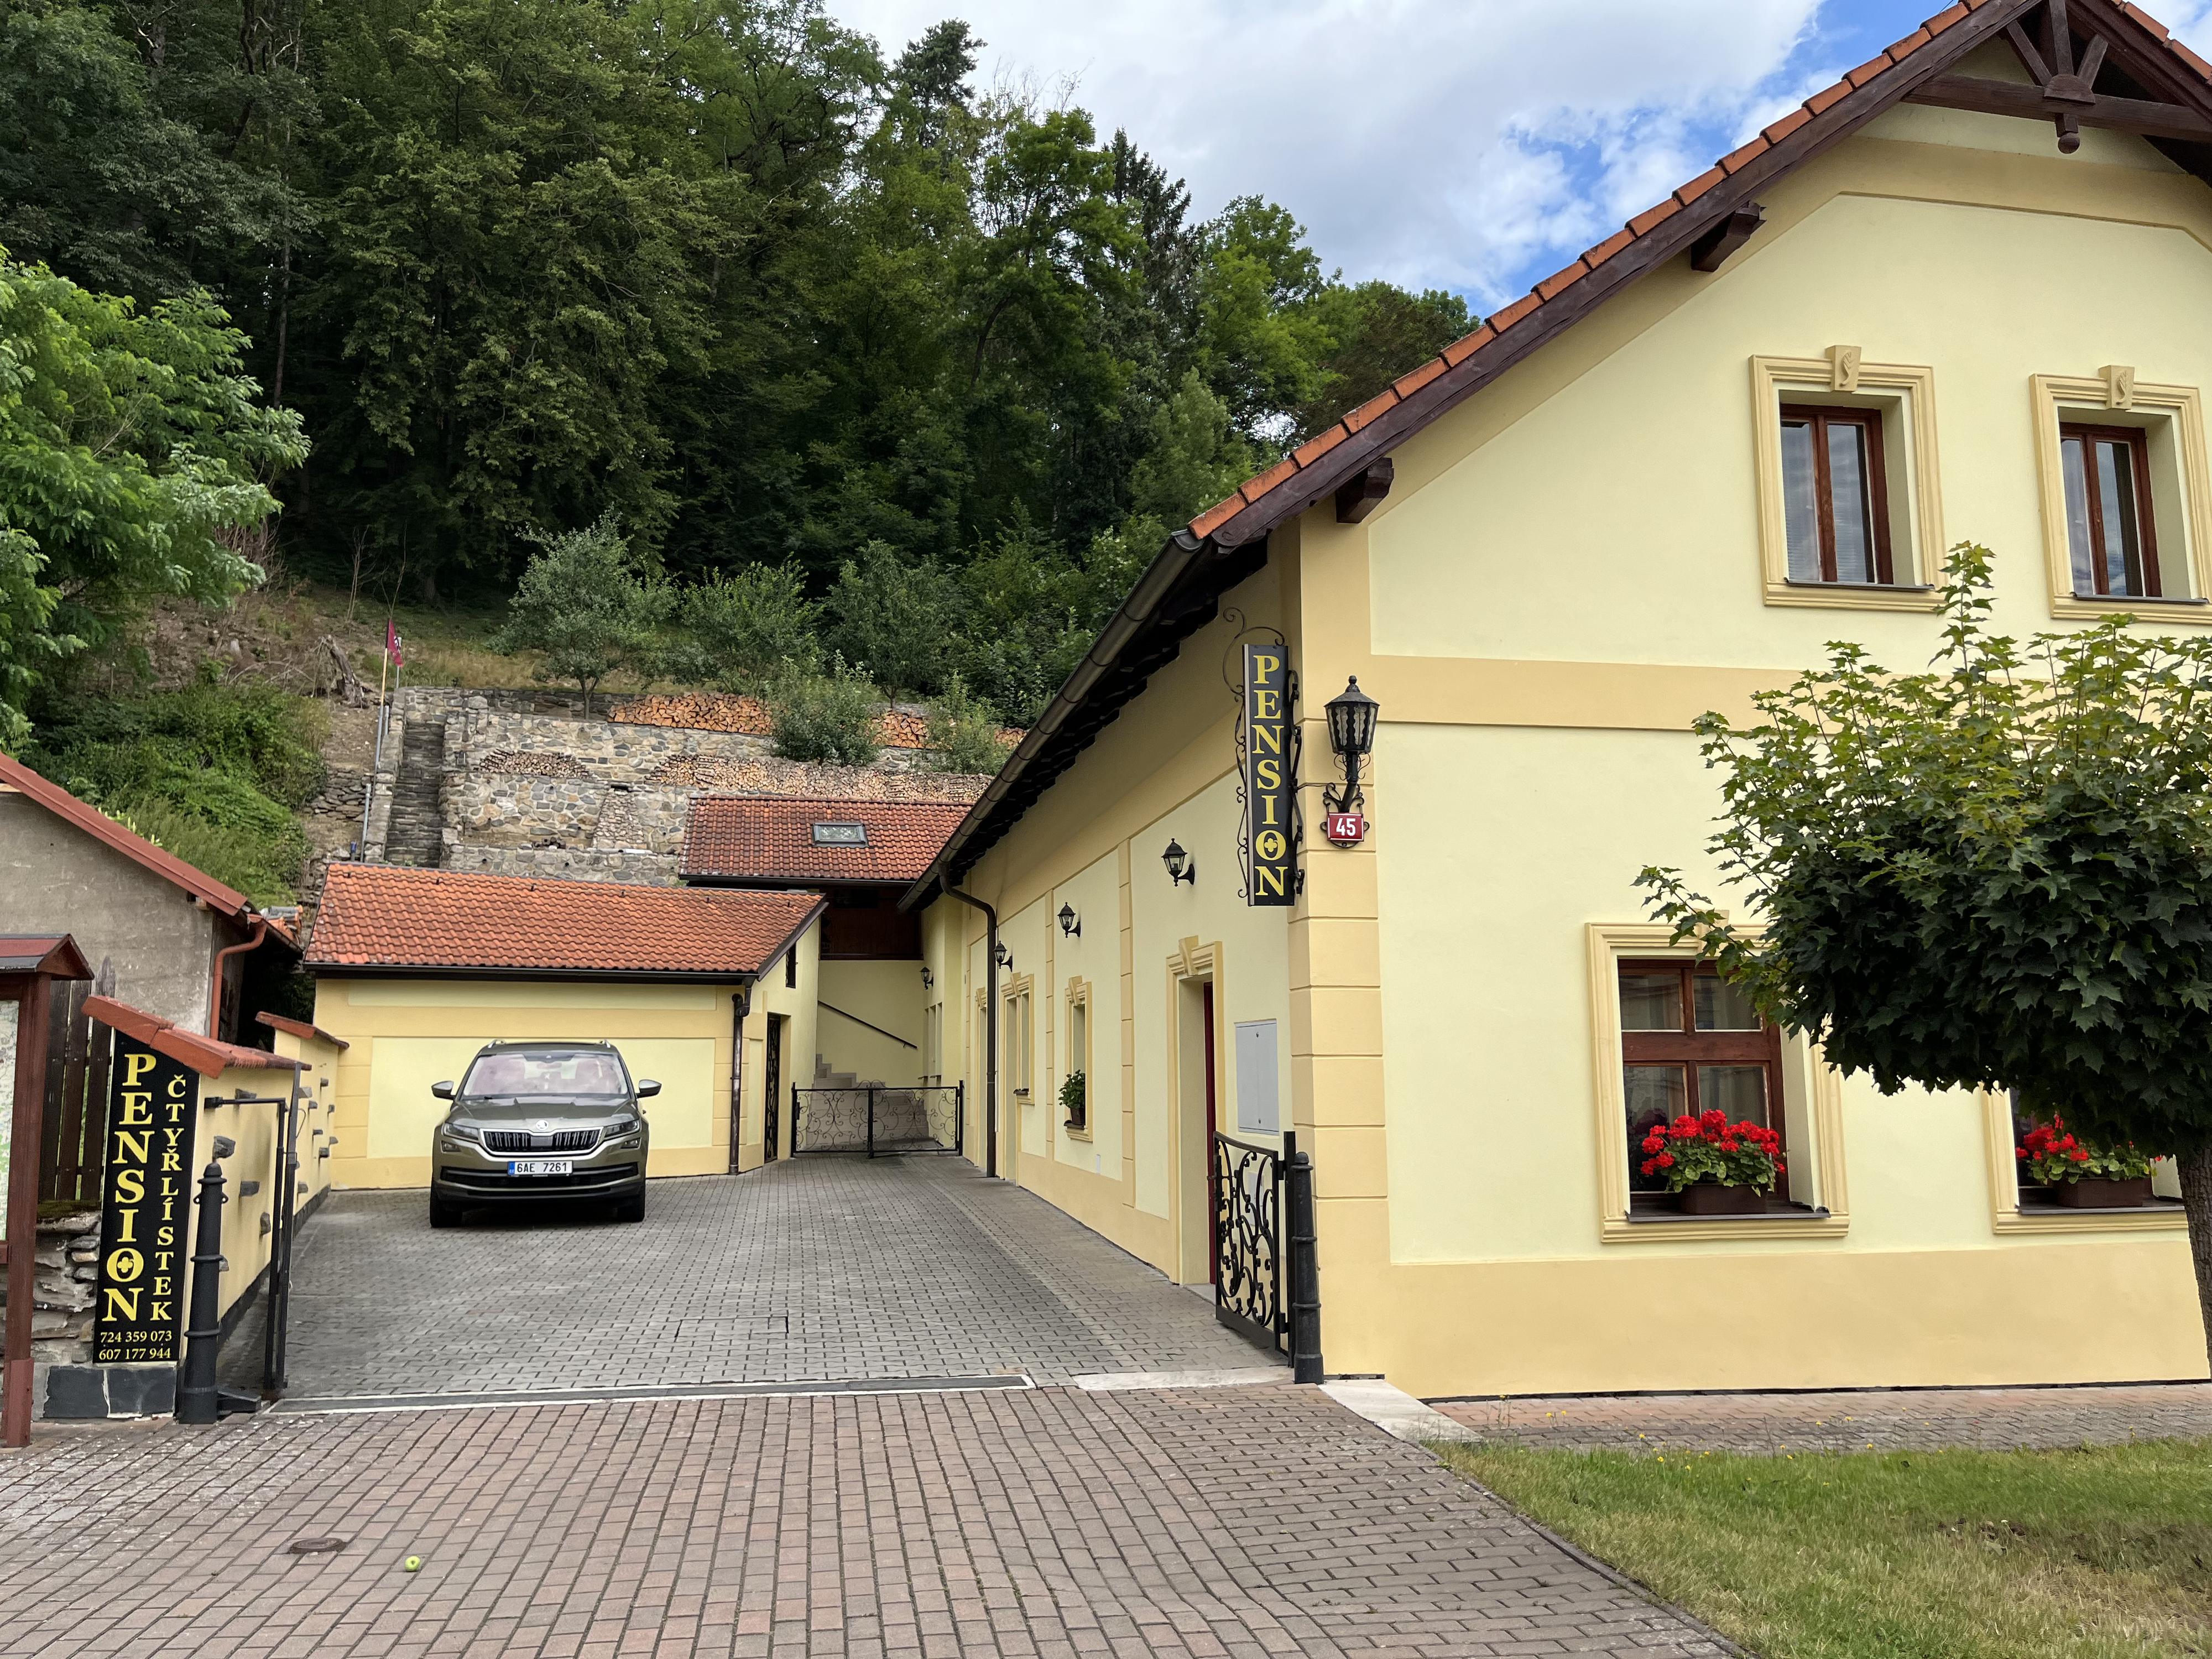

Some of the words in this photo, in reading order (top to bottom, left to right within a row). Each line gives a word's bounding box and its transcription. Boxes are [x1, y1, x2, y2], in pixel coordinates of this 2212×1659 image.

[1251, 654, 1289, 896] PENSION
[1335, 816, 1357, 837] 45
[517, 1163, 535, 1173] 6AE
[543, 1162, 567, 1172] 7261
[102, 1053, 156, 1322] PENSION
[149, 1073, 187, 1322] ČTYŘLÍSTEK
[100, 1332, 122, 1343] 724
[125, 1331, 147, 1343] 359
[150, 1330, 172, 1342] 073
[99, 1349, 121, 1360] 607
[125, 1348, 146, 1360] 177
[149, 1348, 171, 1359] 944
